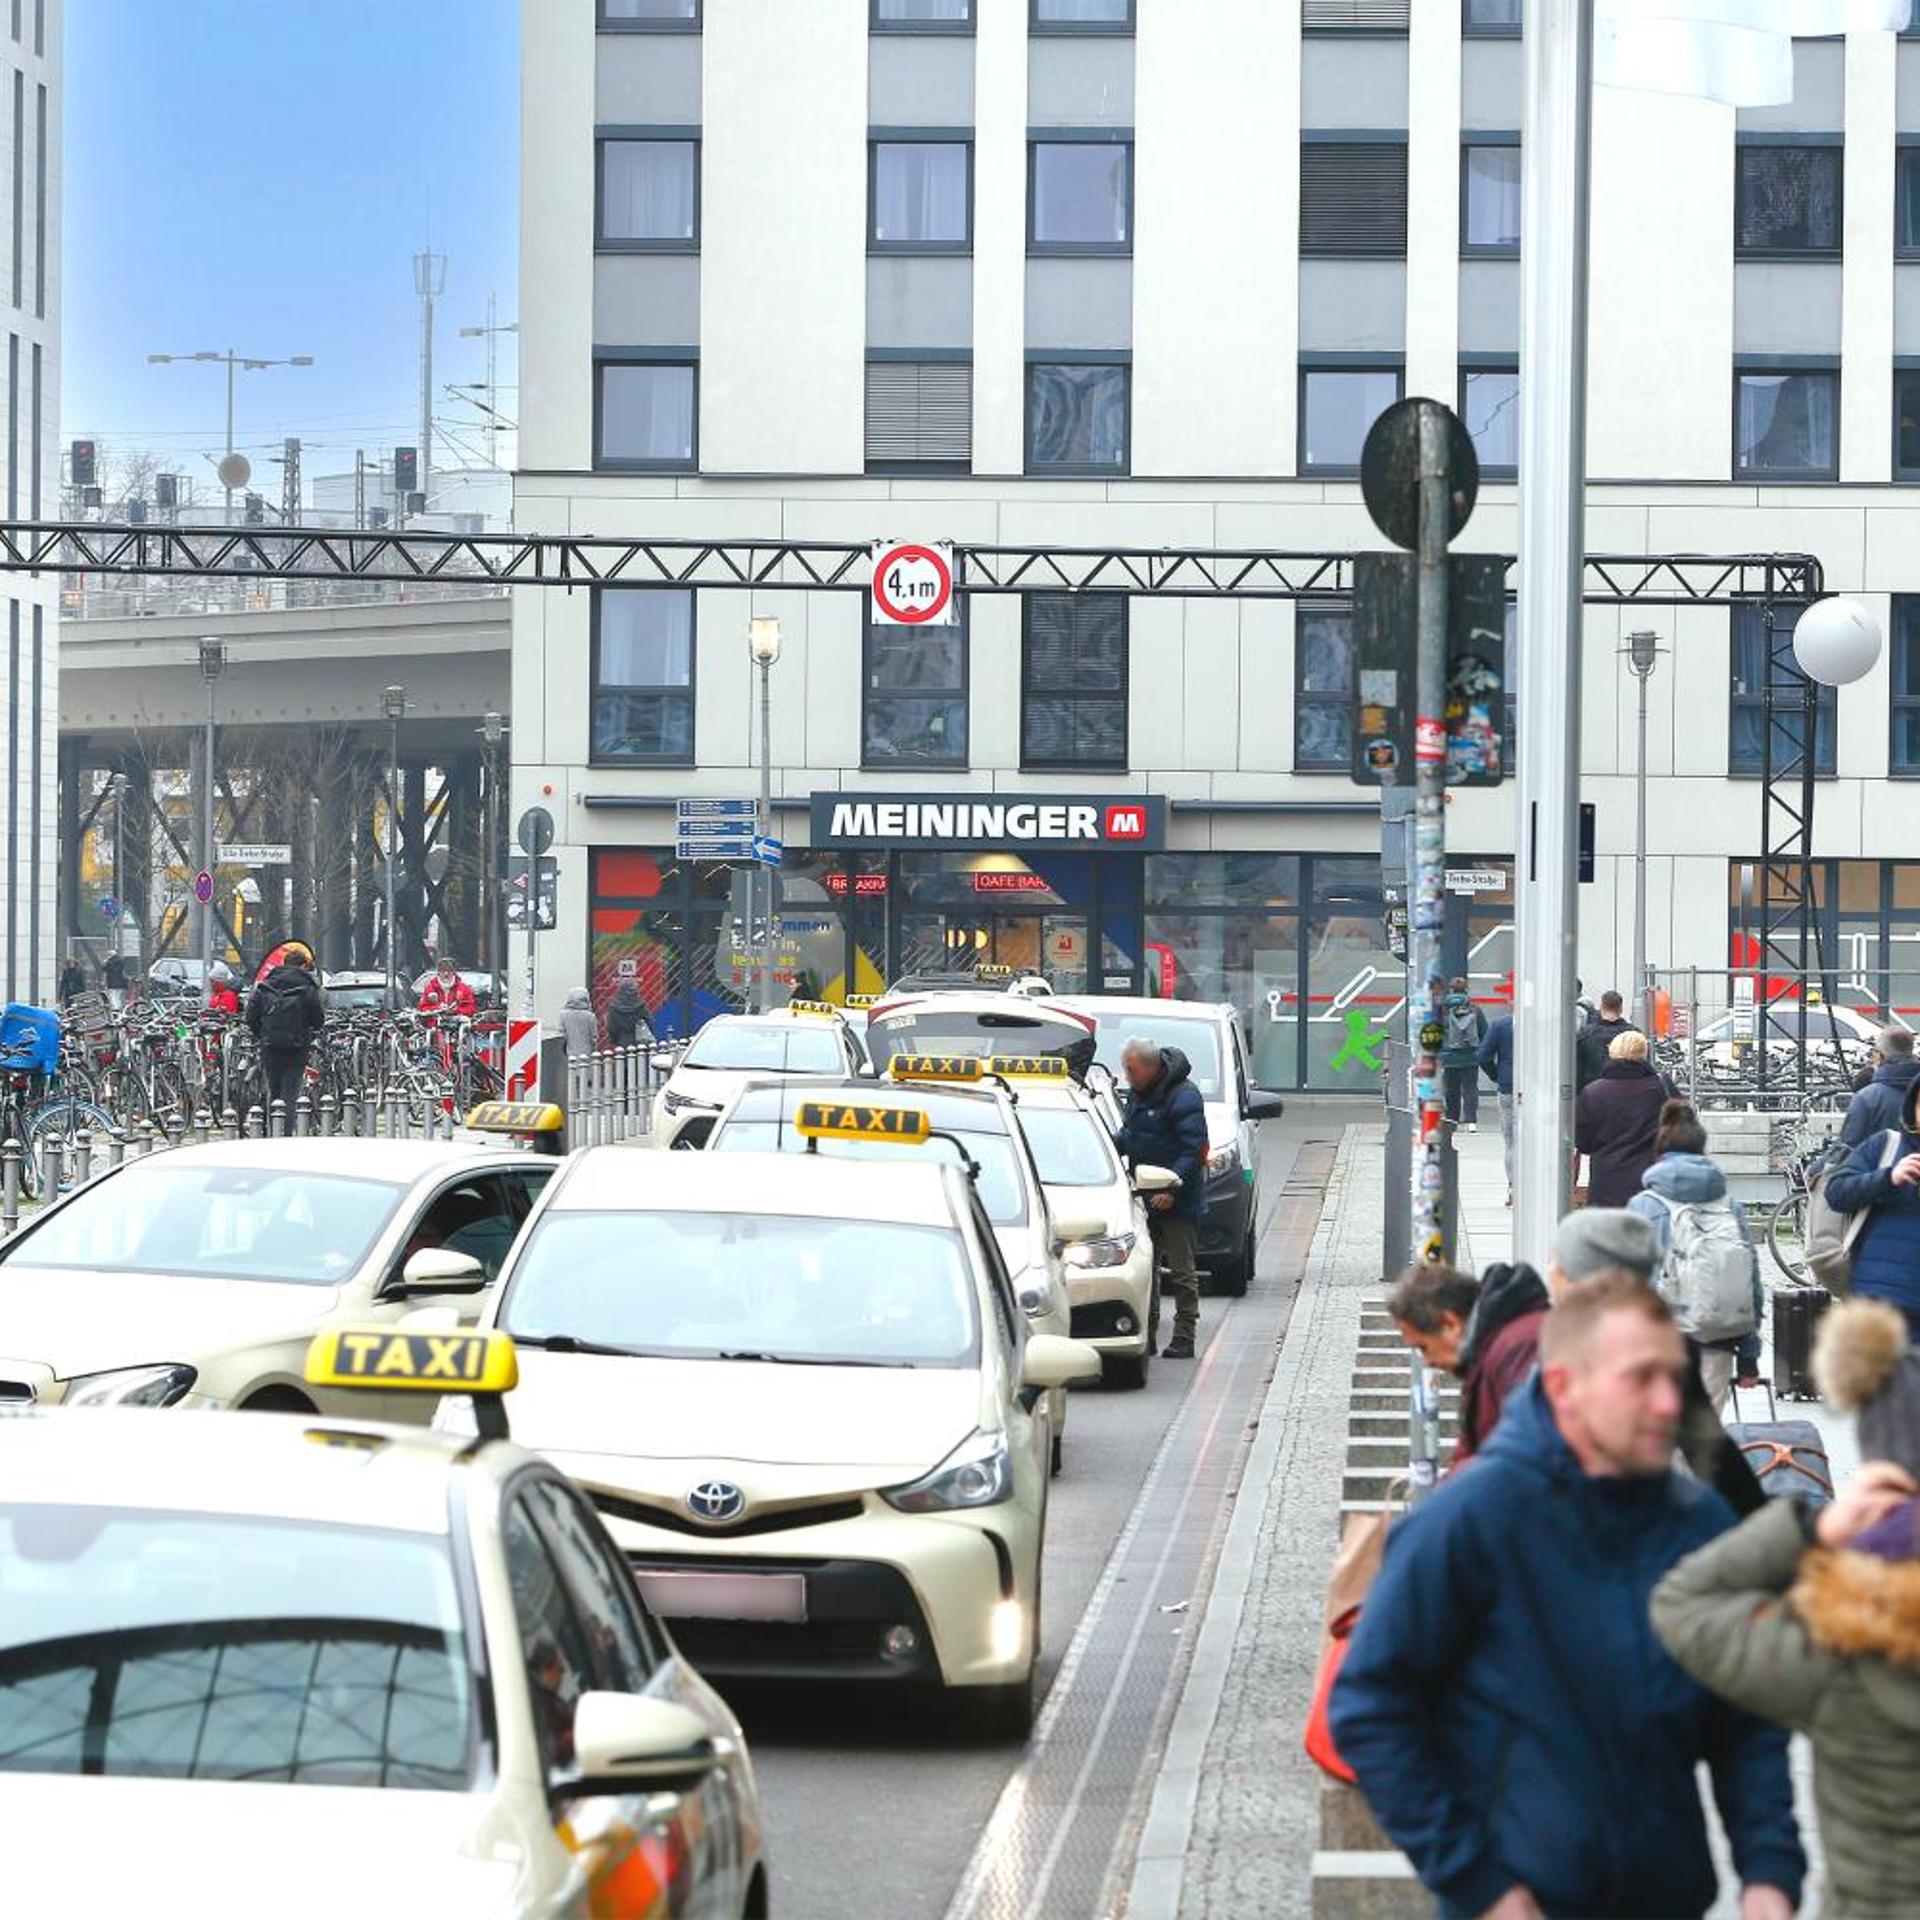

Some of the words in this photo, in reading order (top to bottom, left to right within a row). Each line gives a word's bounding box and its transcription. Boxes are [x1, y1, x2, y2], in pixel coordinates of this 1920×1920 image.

[829, 803, 1099, 840] MEININGER
[1111, 812, 1140, 833] M
[905, 1058, 968, 1074] TAXI
[1001, 1058, 1058, 1073] TAXI
[484, 1105, 541, 1125] TAXI
[816, 1105, 905, 1132] TAXI
[343, 1335, 483, 1378] TAXI
